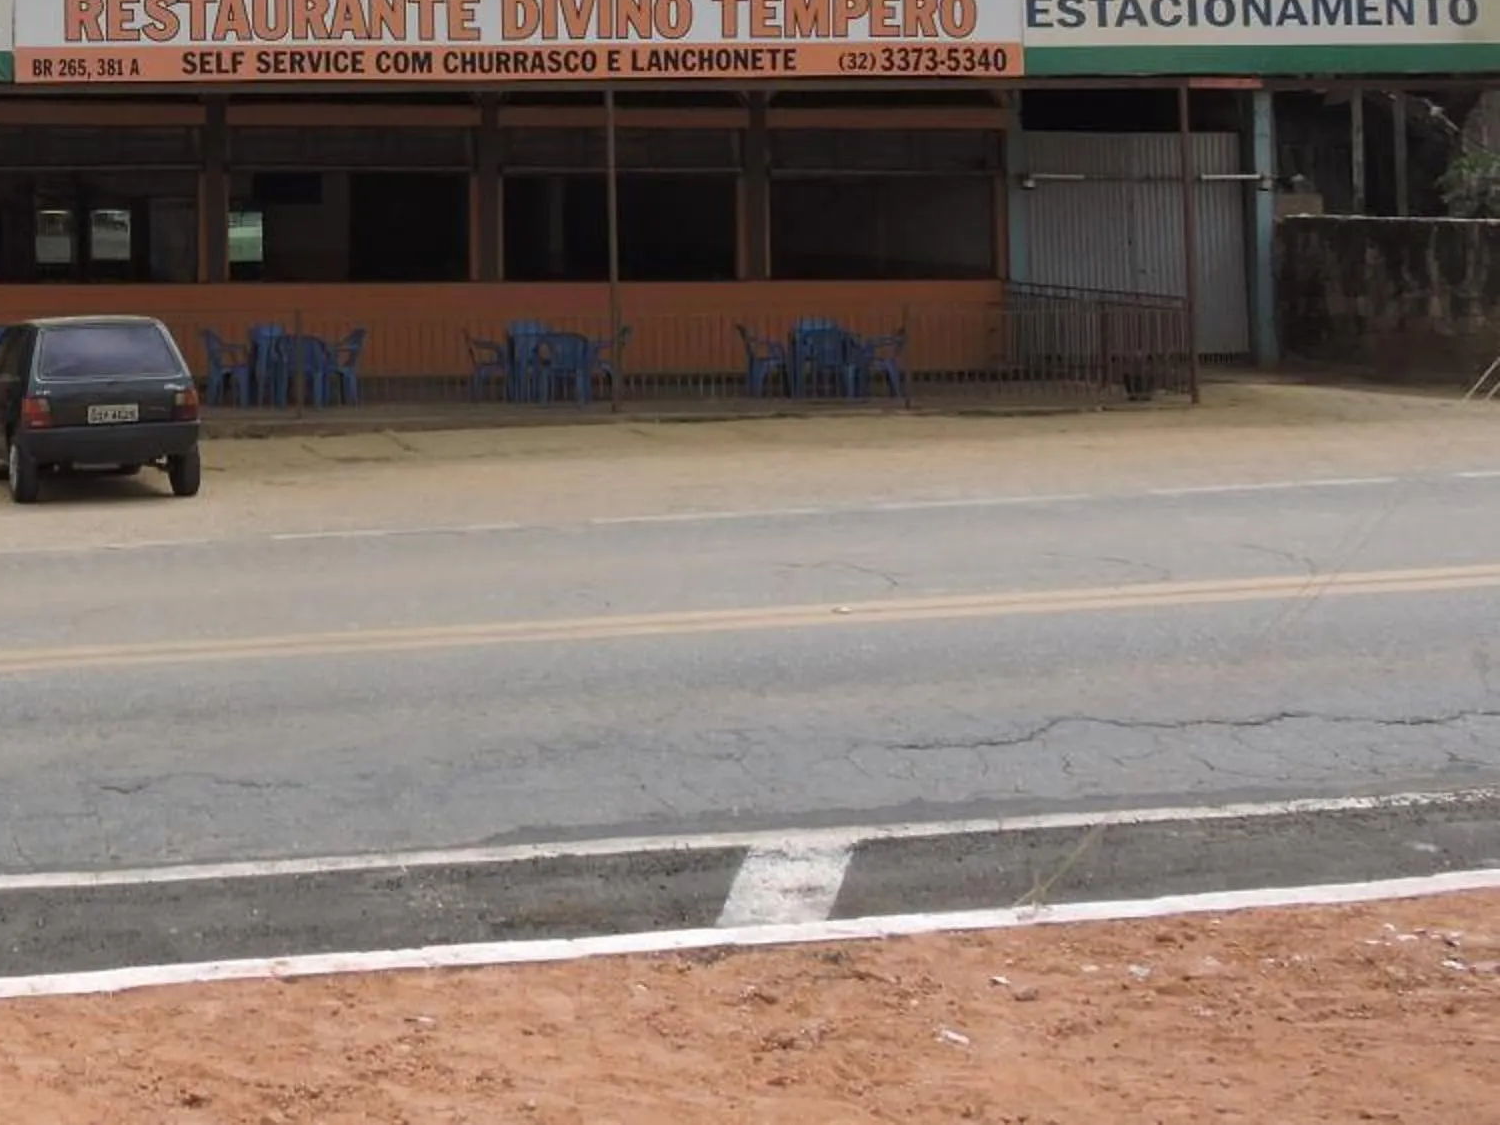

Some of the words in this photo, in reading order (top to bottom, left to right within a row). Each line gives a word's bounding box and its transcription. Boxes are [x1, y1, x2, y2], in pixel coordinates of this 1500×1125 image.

[32, 58, 54, 77] BR
[58, 58, 92, 80] 265,
[97, 58, 125, 77] 381
[129, 58, 140, 76] A
[182, 53, 245, 75] SELF
[256, 52, 365, 74] SERVICE
[375, 51, 433, 73] COM
[443, 49, 597, 74] CHURRASCO
[608, 50, 620, 71] E
[631, 49, 796, 72] LANCHONETE
[838, 51, 877, 72] (32)
[881, 47, 1007, 72] 3373-5340
